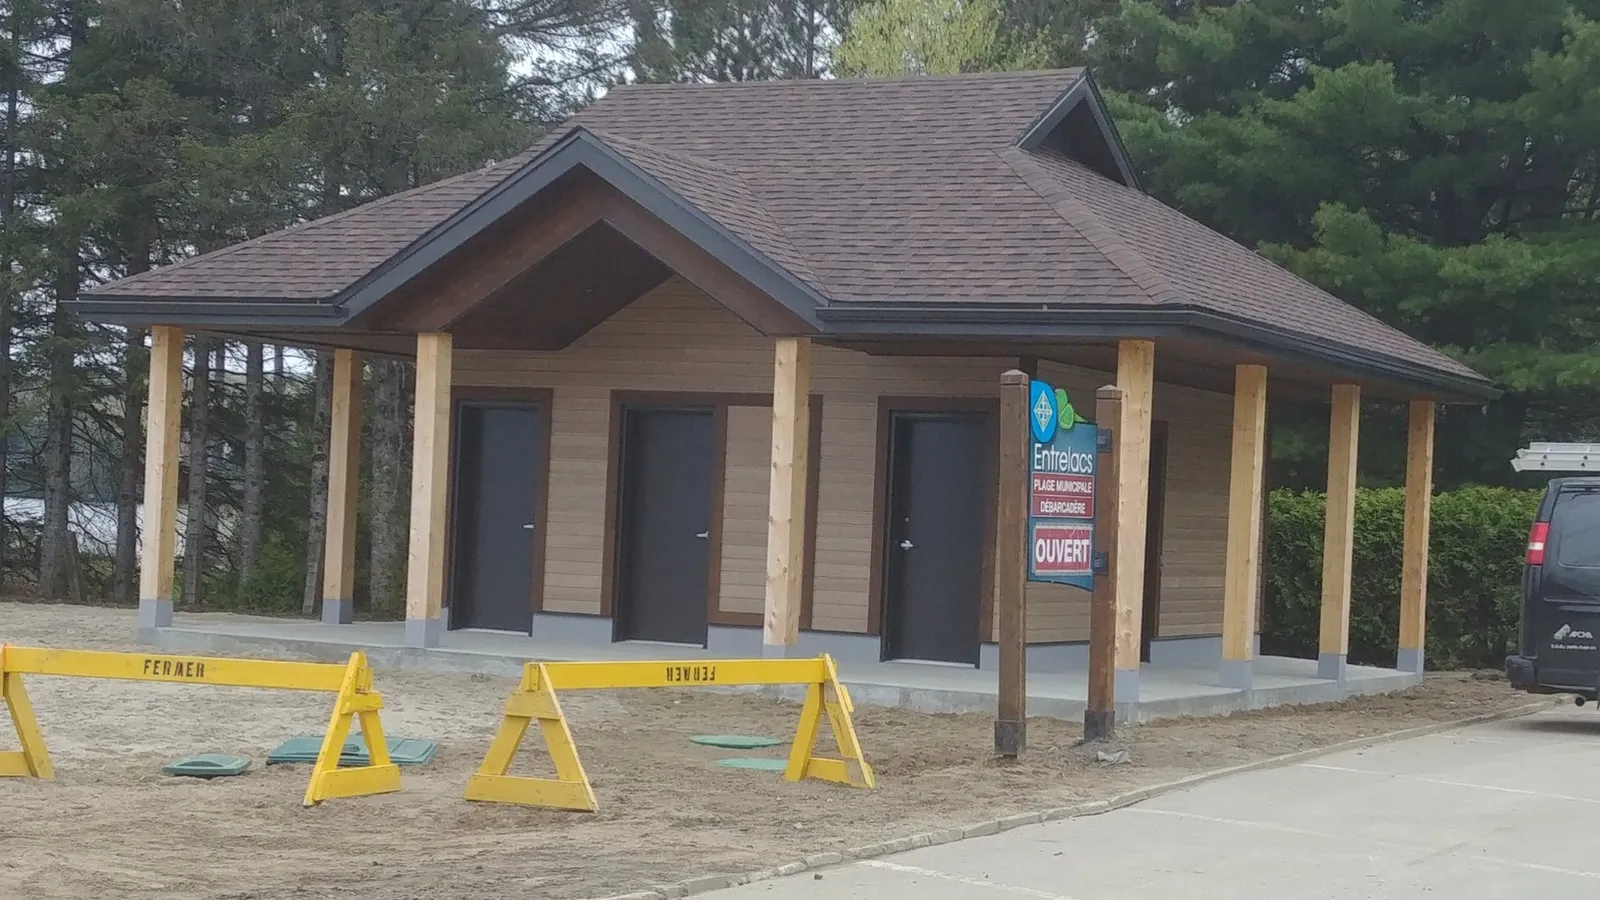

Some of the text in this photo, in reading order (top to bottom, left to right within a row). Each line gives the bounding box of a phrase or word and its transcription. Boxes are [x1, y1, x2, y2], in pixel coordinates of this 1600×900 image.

[1034, 443, 1093, 474] Entrelacs
[1034, 478, 1092, 494] PLAGE MUNICIPALE
[1040, 498, 1086, 514] DÉBARCADÈRE
[1035, 538, 1090, 563] OUVERT
[143, 659, 205, 678] FERMER
[666, 665, 716, 682] FERMER
